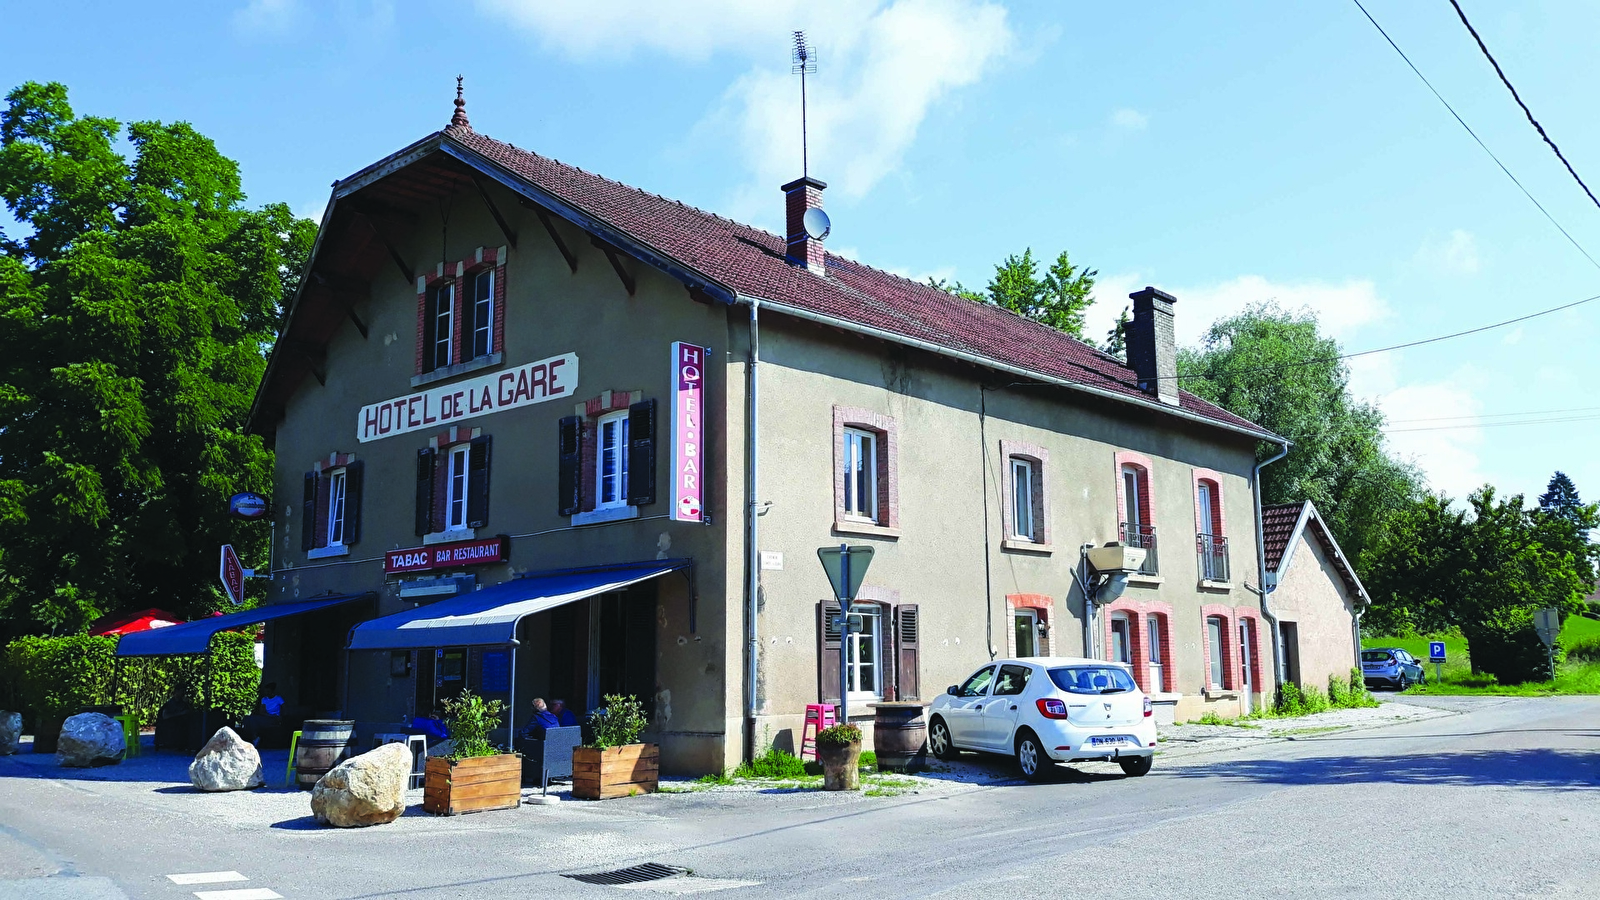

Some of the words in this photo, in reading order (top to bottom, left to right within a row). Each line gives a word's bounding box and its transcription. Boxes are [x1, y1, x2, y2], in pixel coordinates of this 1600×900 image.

[365, 393, 437, 438] HOTEL
[441, 391, 464, 420] DE
[469, 385, 493, 414] LA
[498, 358, 566, 407] GARE
[682, 348, 700, 429] HOTEL
[683, 442, 698, 490] BAR
[391, 552, 428, 568] TABAC
[436, 549, 451, 562] BAR
[453, 543, 499, 561] RESTAURANT
[1433, 645, 1441, 655] P
